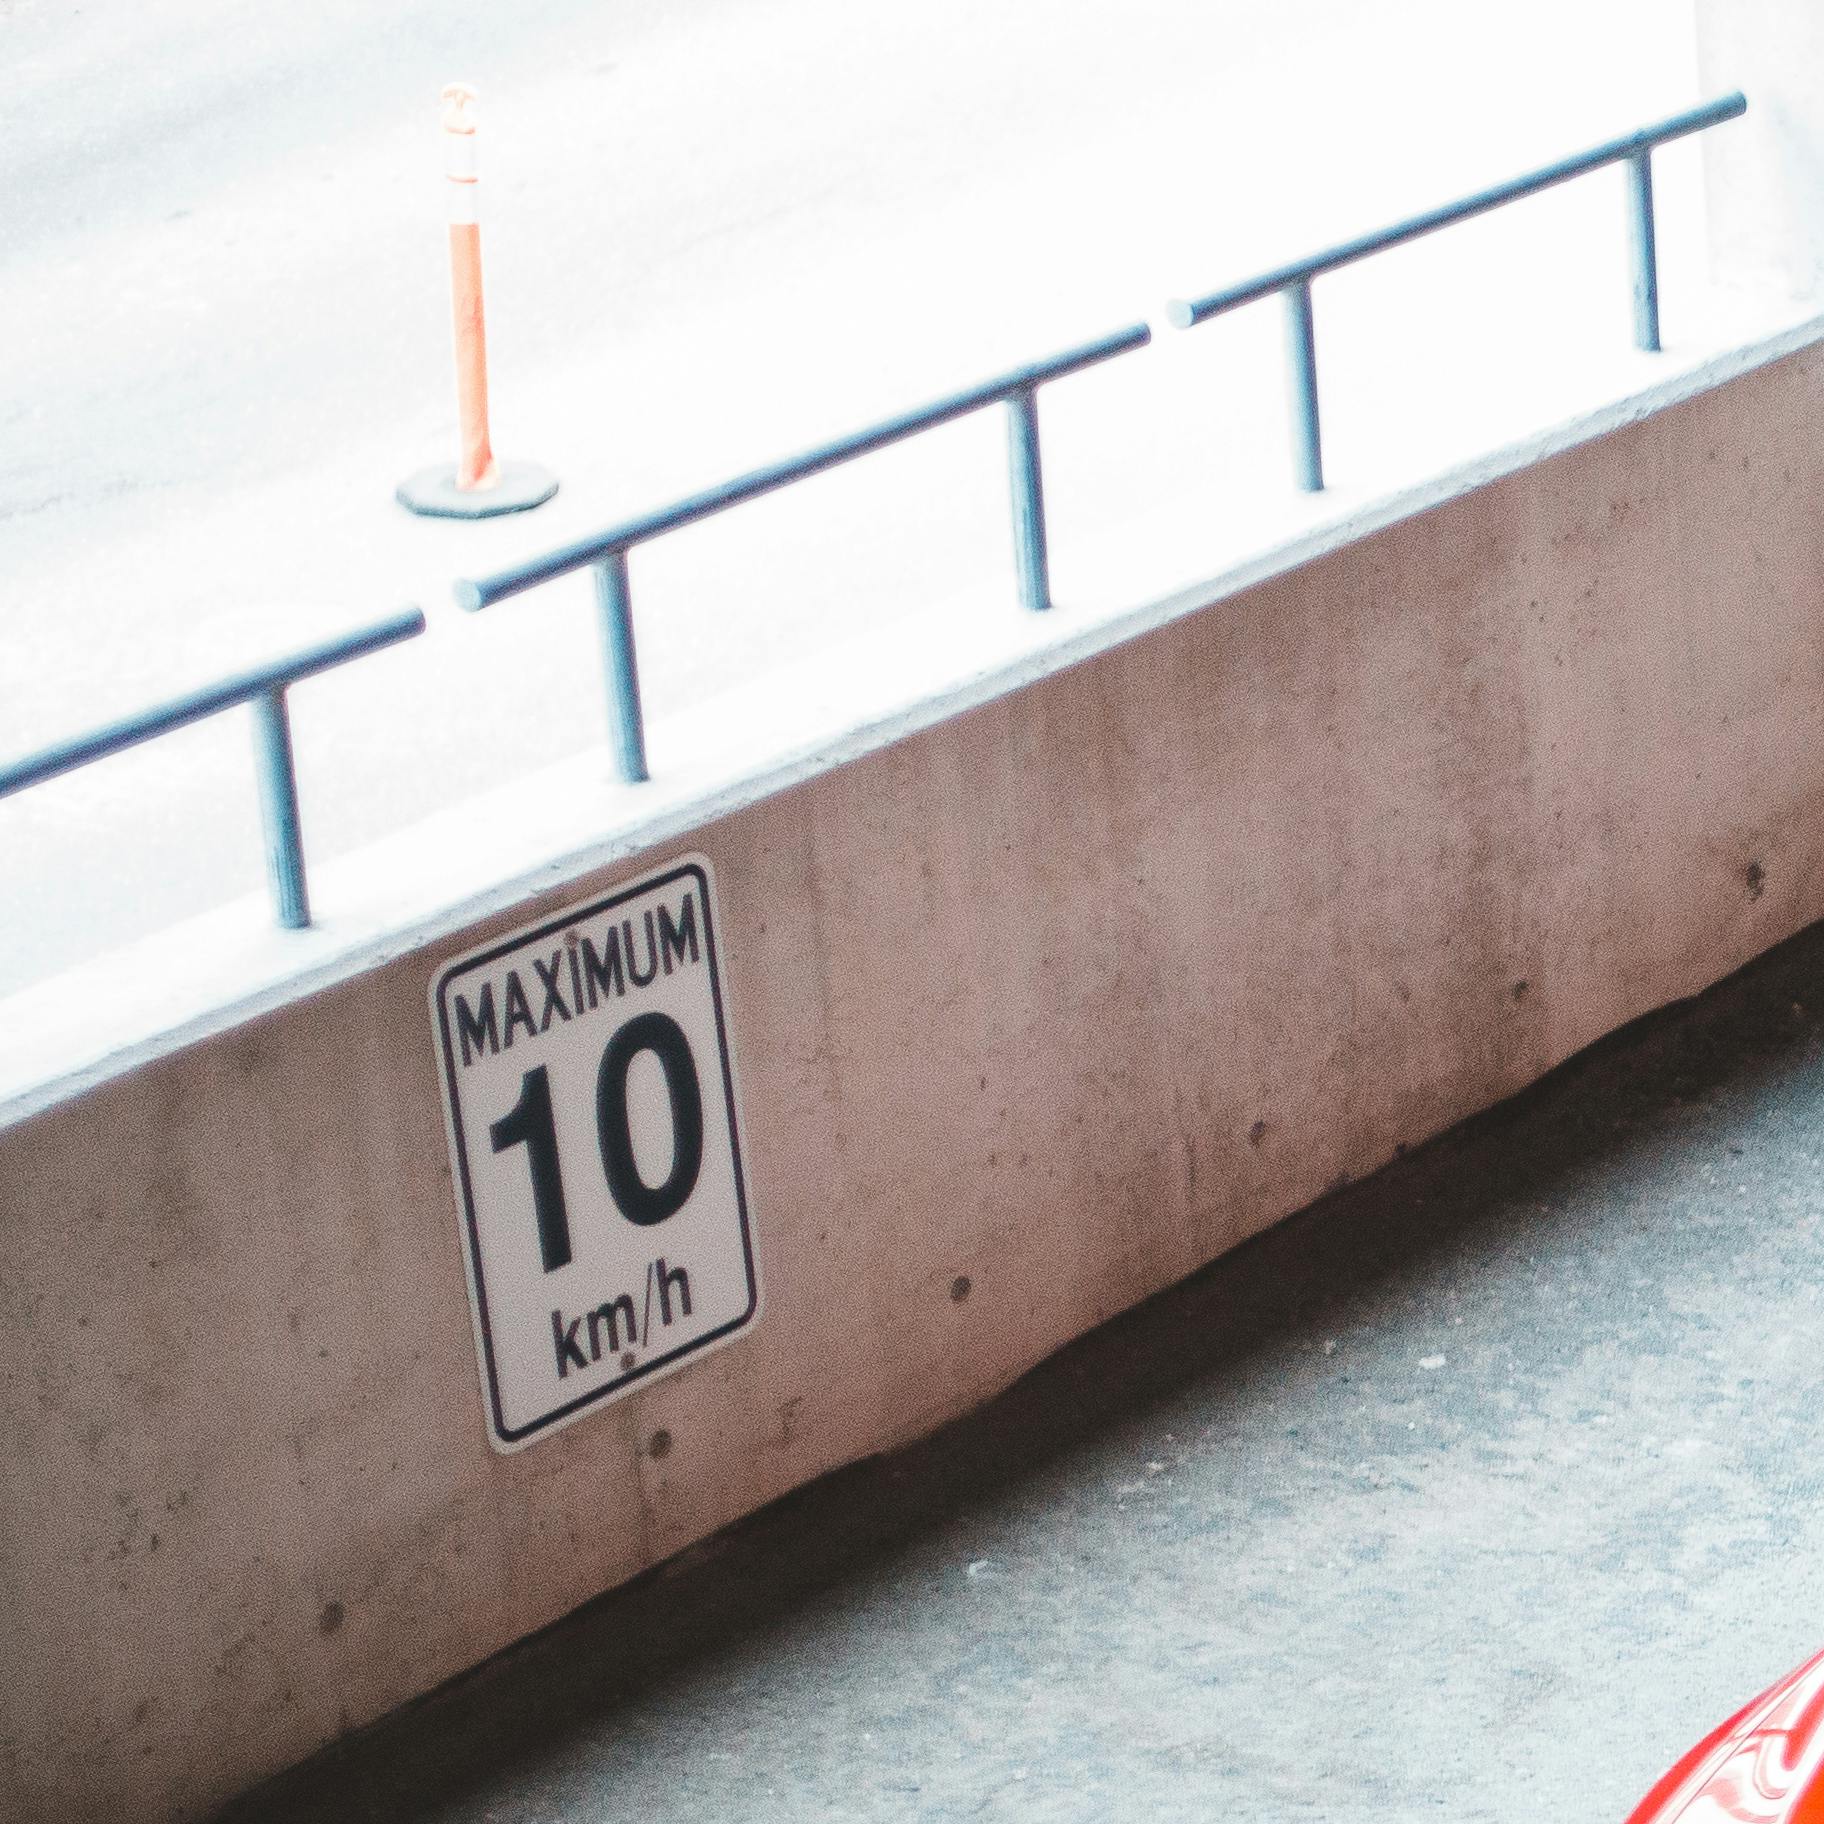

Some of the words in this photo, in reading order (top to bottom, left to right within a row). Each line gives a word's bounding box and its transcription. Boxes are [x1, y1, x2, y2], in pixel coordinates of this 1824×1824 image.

[453, 893, 701, 1068] MAXIMUM
[488, 1010, 704, 1275] 10
[550, 1256, 693, 1380] km/h
